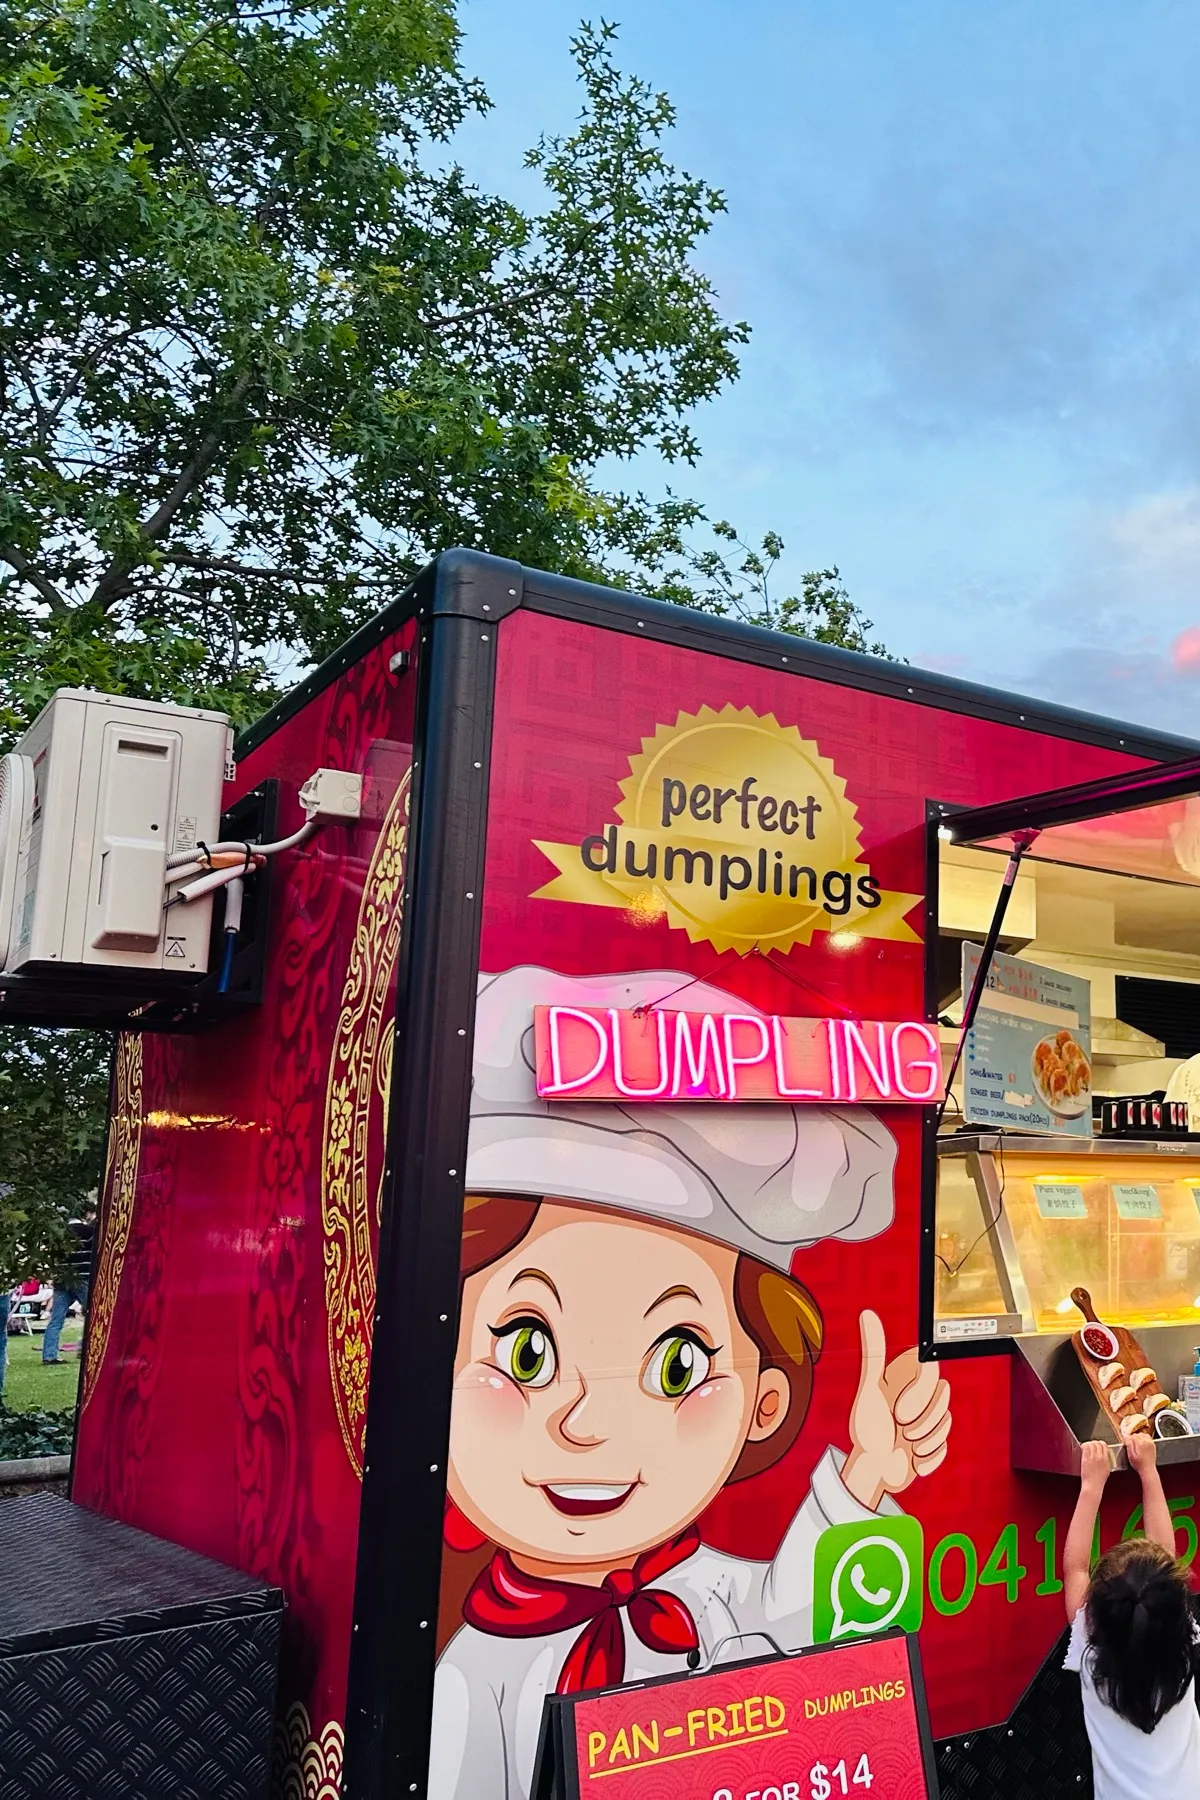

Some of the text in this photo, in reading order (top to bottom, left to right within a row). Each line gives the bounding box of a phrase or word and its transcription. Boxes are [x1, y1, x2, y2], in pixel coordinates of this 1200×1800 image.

[662, 776, 821, 839] perfect
[581, 825, 881, 914] dumplings
[539, 1005, 940, 1101] DUMPLING
[588, 1679, 906, 1768] PAN-FRIED DUMPLINGS
[809, 1752, 874, 1800] $14
